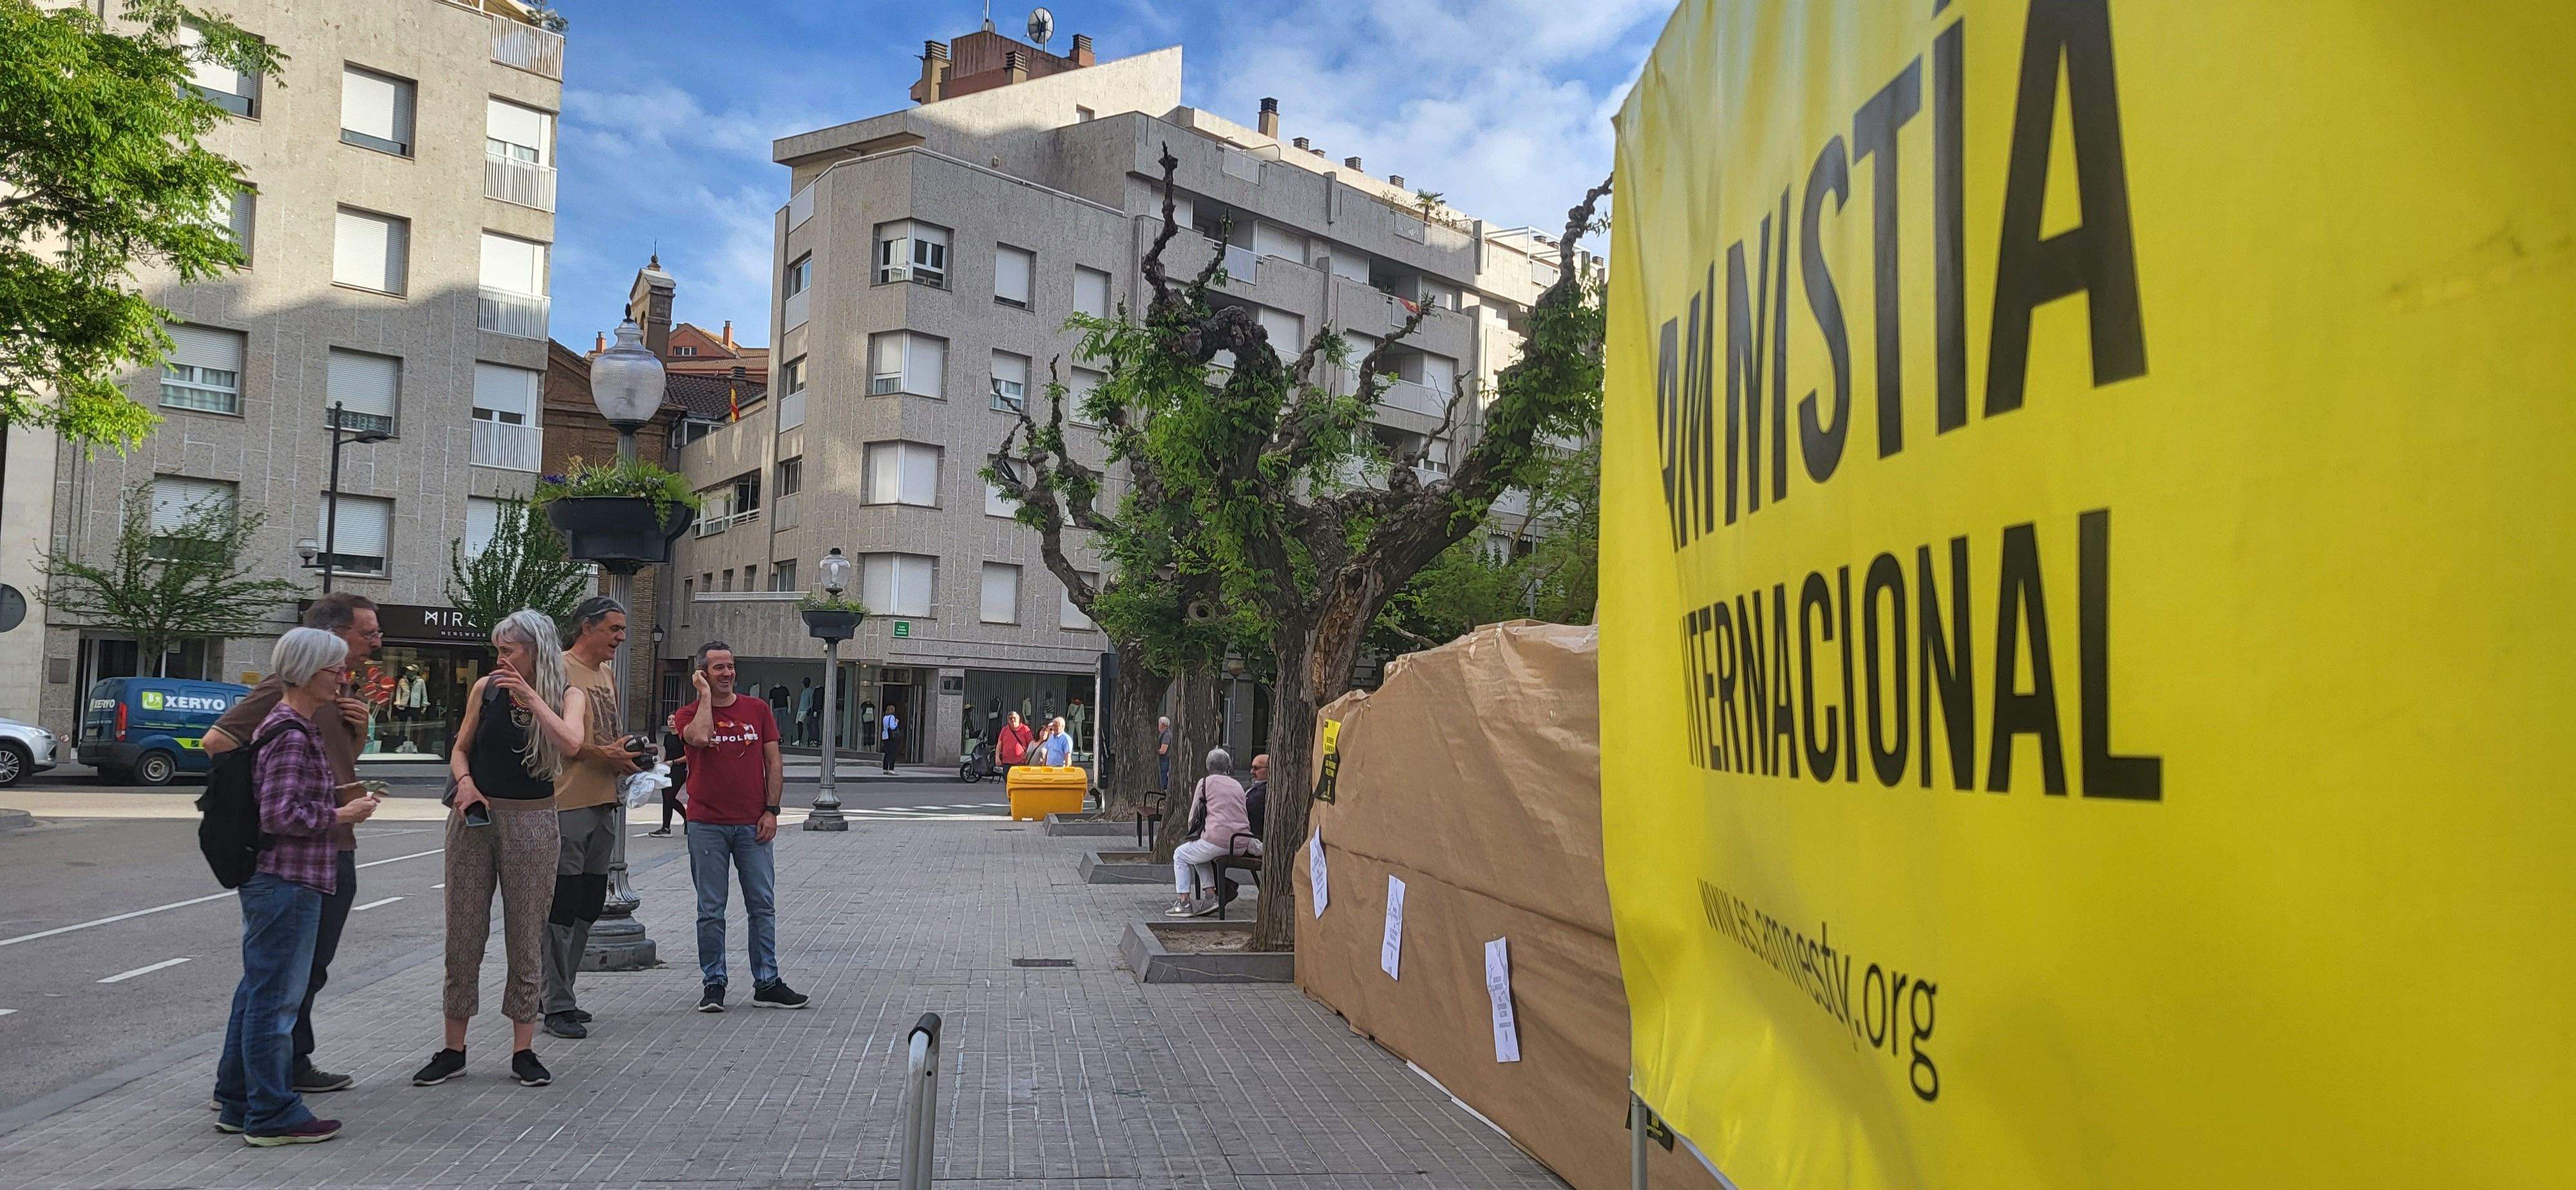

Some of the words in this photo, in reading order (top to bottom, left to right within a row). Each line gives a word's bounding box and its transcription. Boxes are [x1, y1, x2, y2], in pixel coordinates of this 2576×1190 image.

[93, 699, 115, 708] XERYO
[164, 695, 225, 711] XERYO
[1678, 507, 2163, 802] NTERNACIONAL
[1696, 876, 1939, 1103] www.es.amnesty.org
